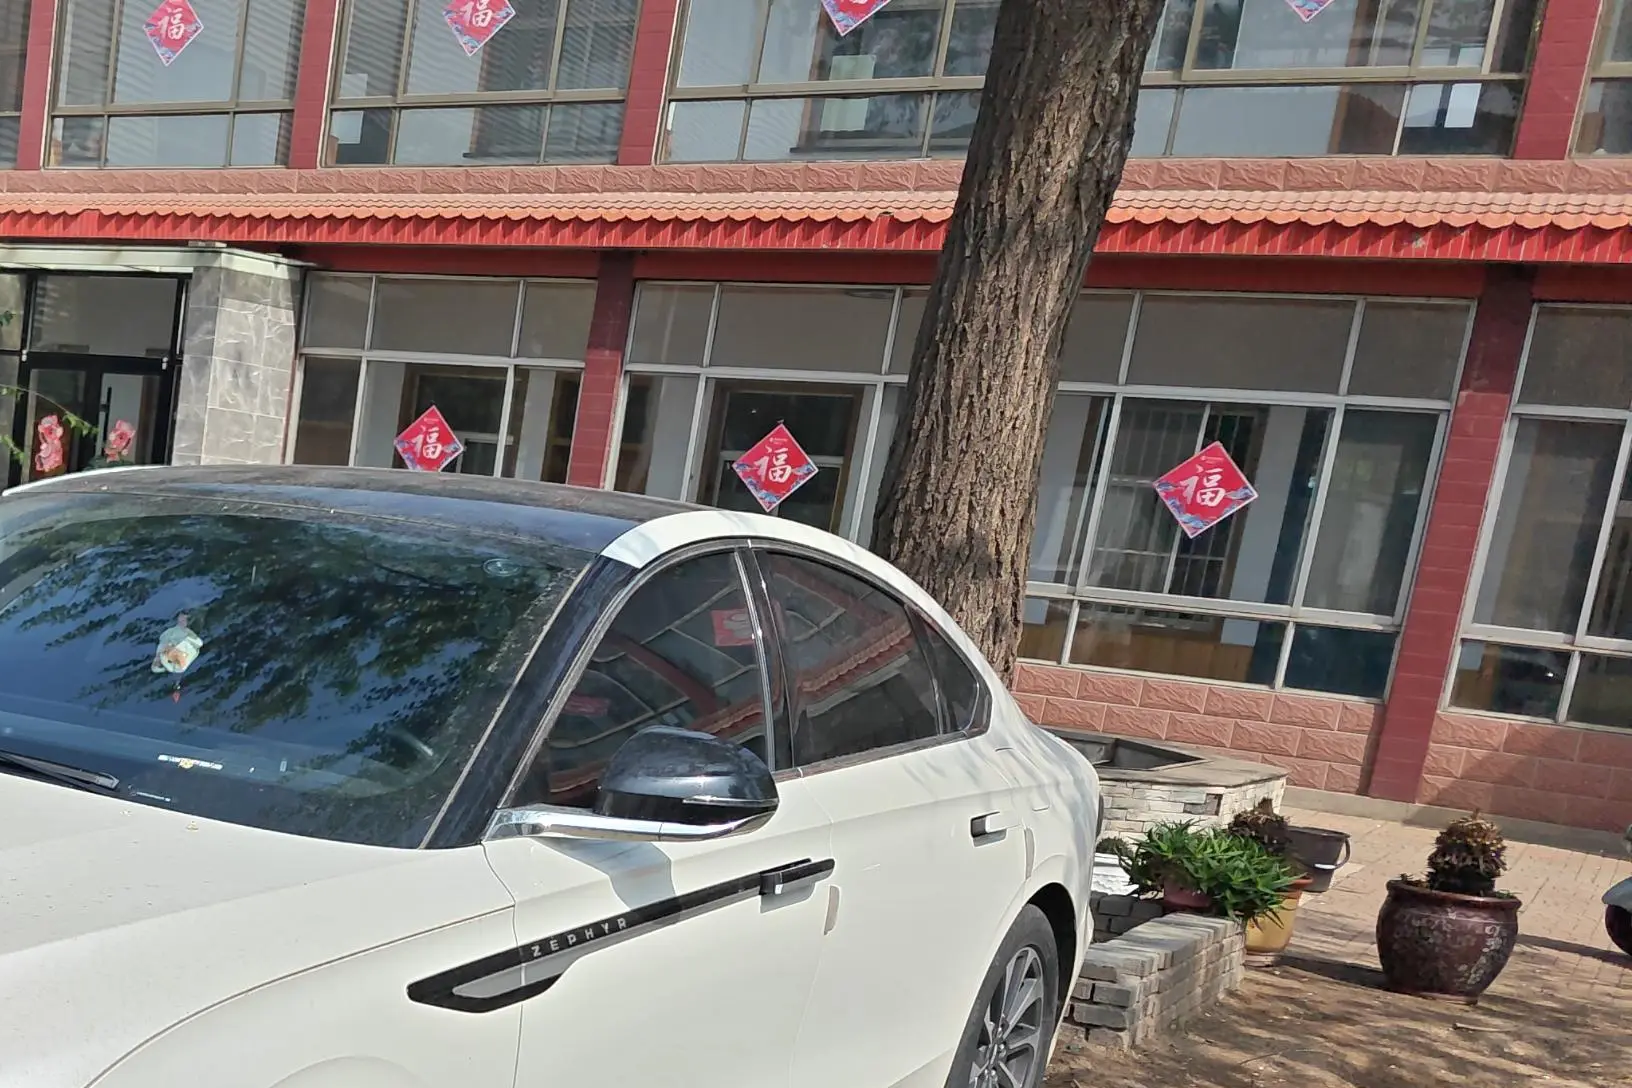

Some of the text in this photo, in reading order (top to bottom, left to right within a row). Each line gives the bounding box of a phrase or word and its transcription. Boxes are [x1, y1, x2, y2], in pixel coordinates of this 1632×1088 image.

[157, 7, 185, 40] 福
[460, 0, 494, 28] 福
[412, 425, 442, 459] 福
[754, 445, 792, 483] 福
[1180, 464, 1226, 507] 福
[531, 917, 627, 958] ZEPHYR
